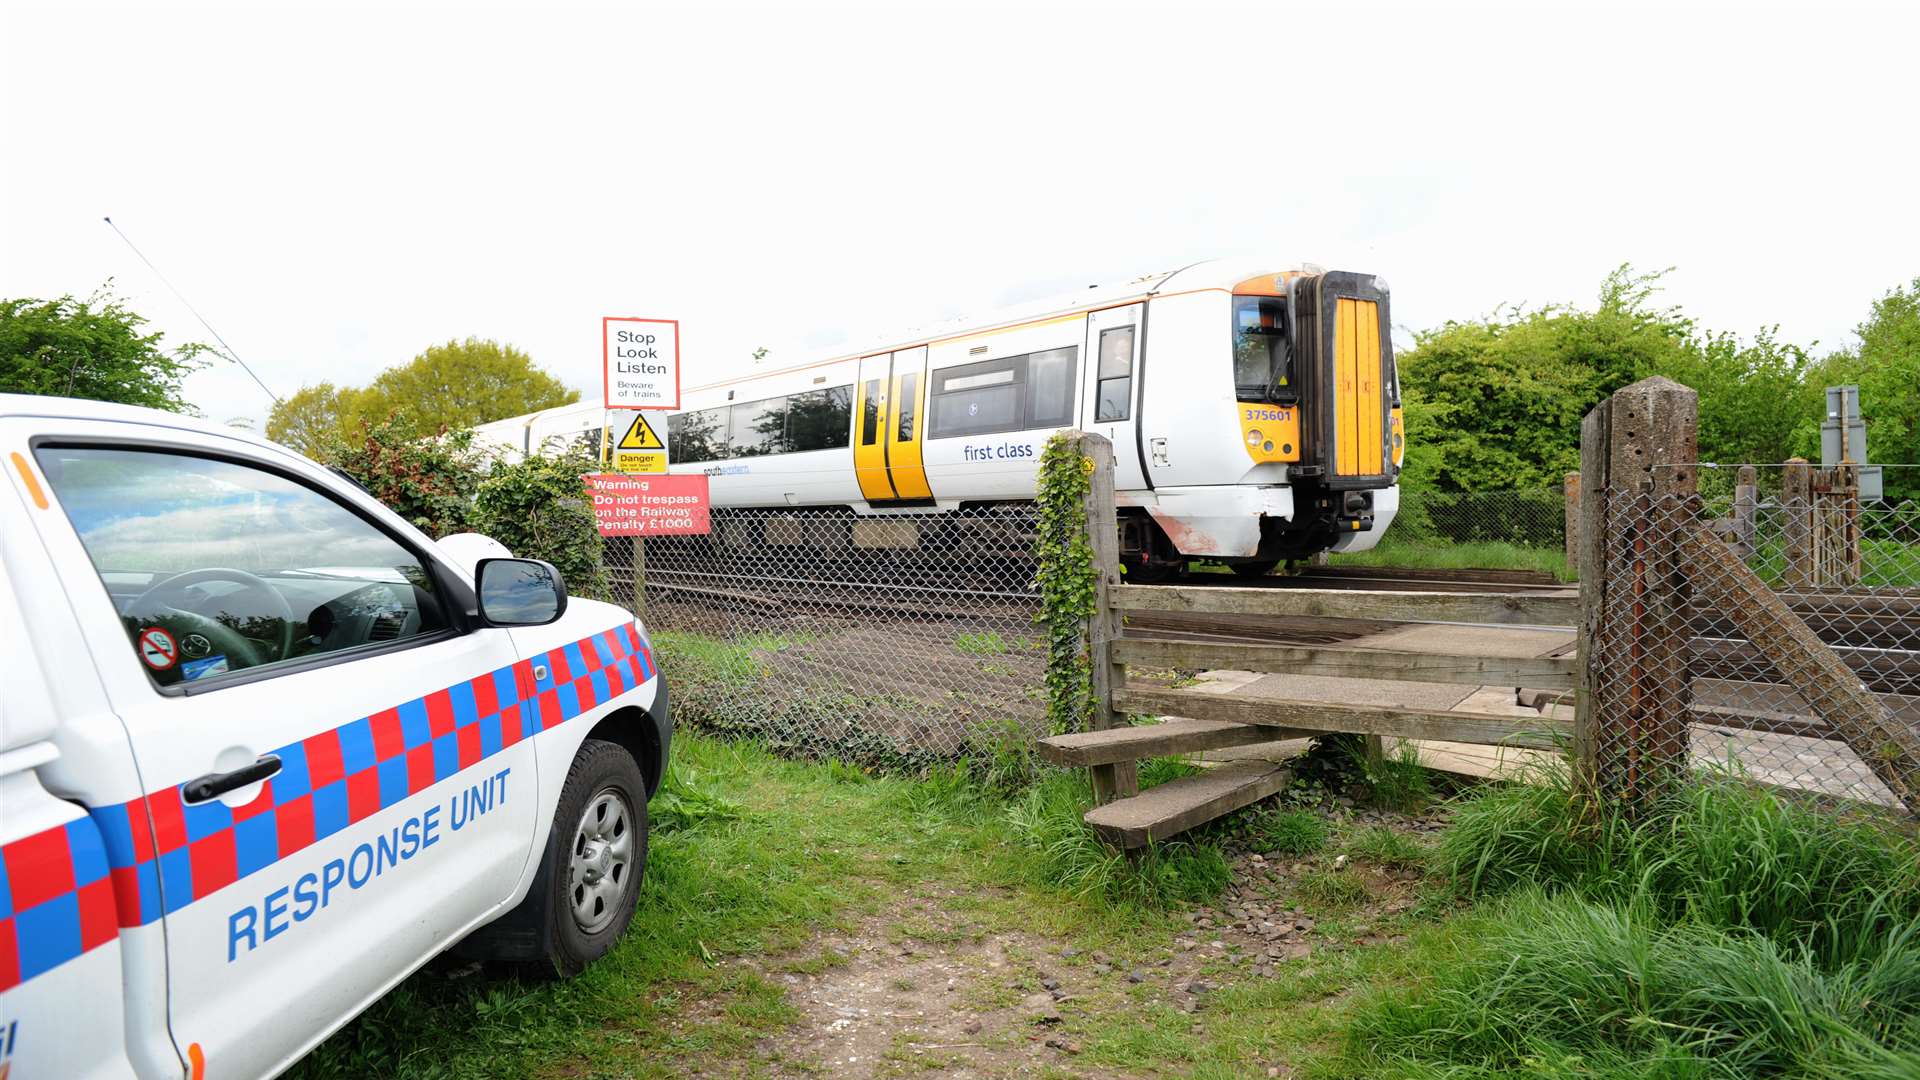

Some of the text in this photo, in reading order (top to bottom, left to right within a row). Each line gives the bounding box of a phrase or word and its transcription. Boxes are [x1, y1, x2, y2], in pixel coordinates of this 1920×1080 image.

[617, 330, 656, 346] Stop
[617, 346, 658, 359] Look
[617, 361, 667, 374] Listen
[617, 380, 654, 390] Beware
[633, 390, 661, 399] trains
[1247, 409, 1291, 421] 375601
[964, 442, 1033, 461] first class
[620, 454, 656, 463] Danger
[593, 480, 649, 491] Warning
[594, 494, 699, 505] Do not trespass
[595, 507, 690, 518] on the Railway
[596, 518, 693, 531] Penalty £1000
[228, 767, 511, 963] RESPONSE UNIT
